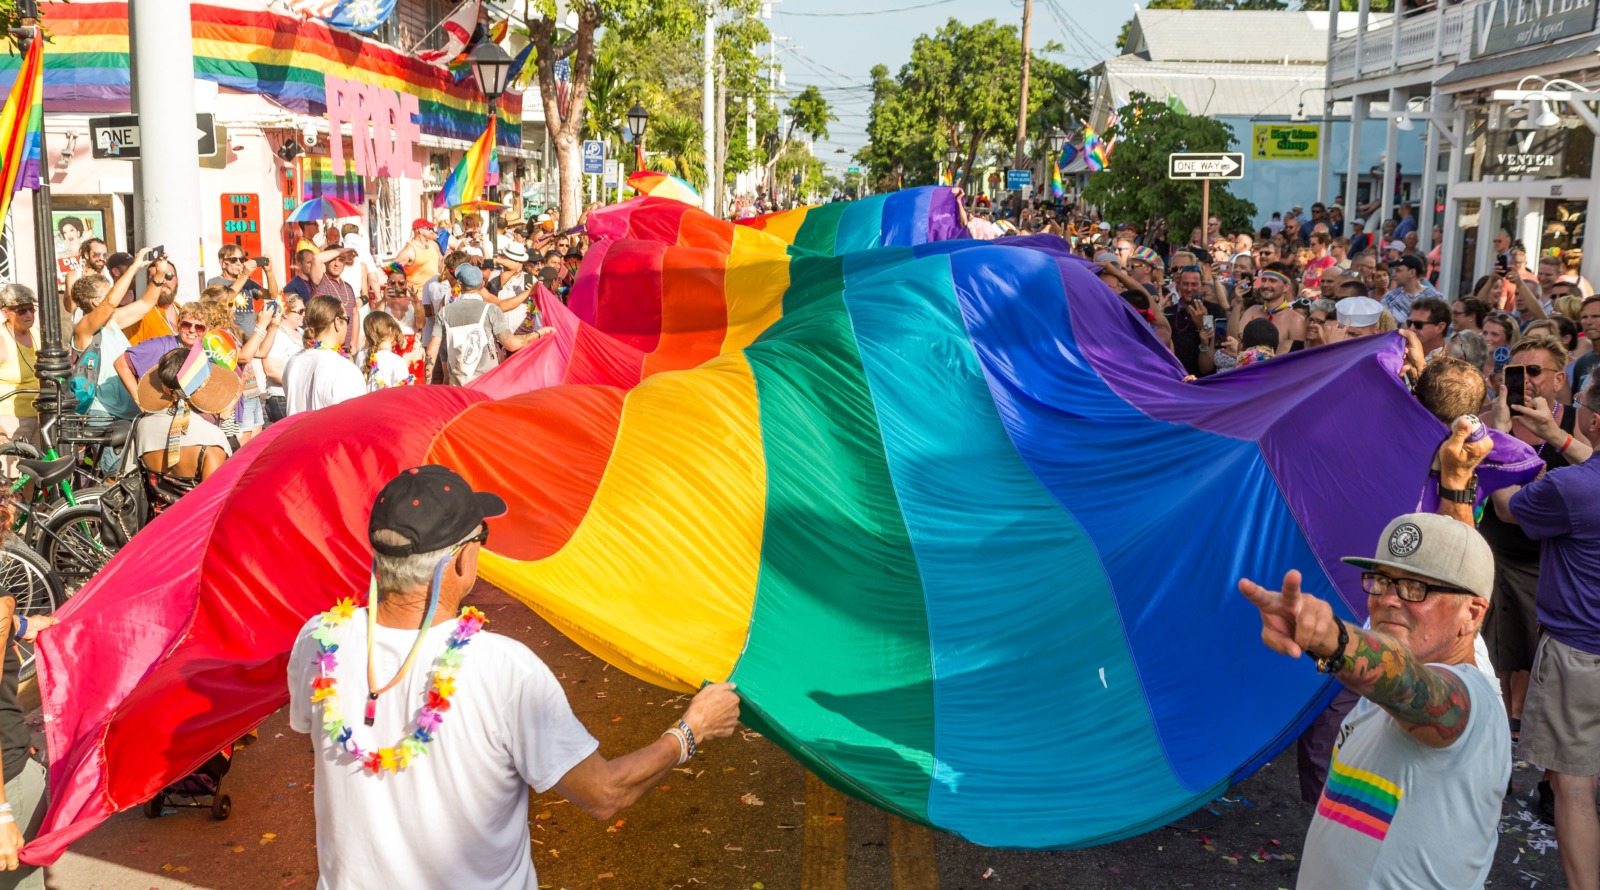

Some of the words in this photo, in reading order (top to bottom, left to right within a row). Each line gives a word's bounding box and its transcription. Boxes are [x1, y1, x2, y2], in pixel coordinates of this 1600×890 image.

[324, 73, 422, 180] PRIDE
[1271, 129, 1291, 142] Key
[1277, 140, 1309, 151] Shop
[1177, 161, 1196, 171] ONE
[1200, 161, 1220, 171] WAY
[1497, 154, 1554, 166] VENTER
[229, 195, 249, 203] THE
[233, 205, 248, 218] B
[224, 220, 257, 233] 801
